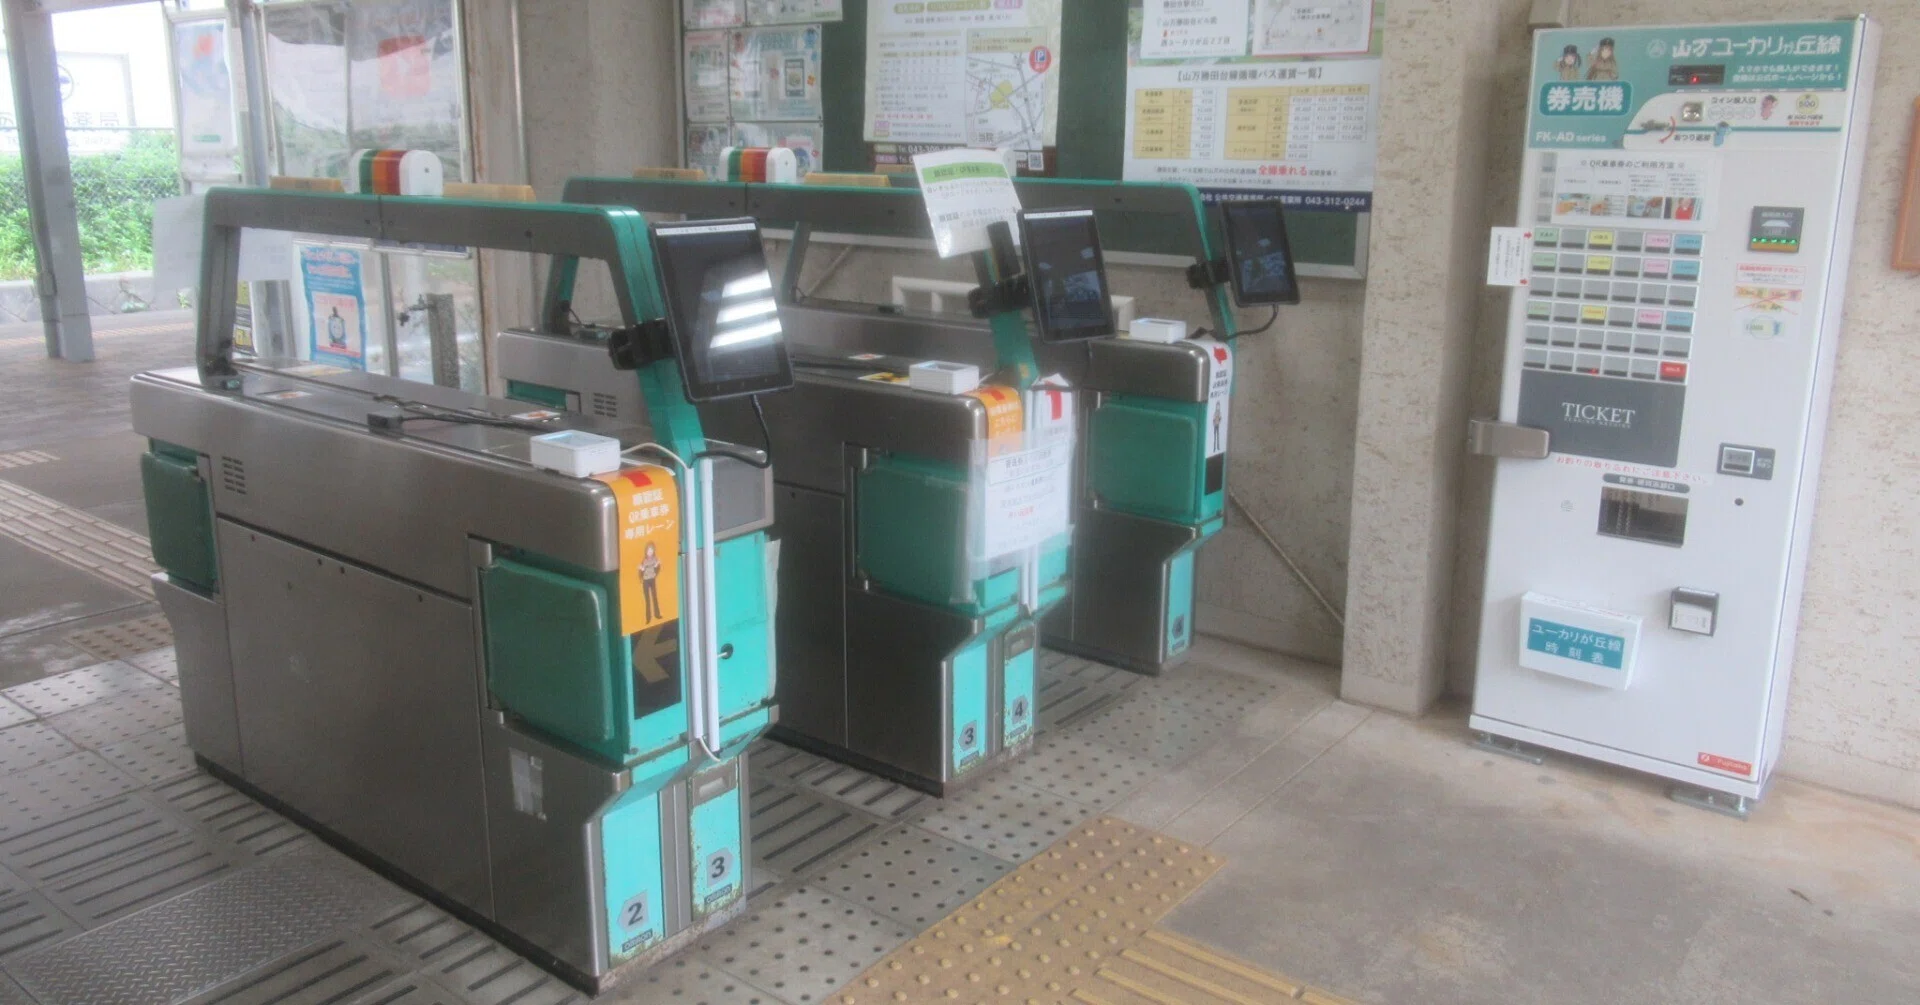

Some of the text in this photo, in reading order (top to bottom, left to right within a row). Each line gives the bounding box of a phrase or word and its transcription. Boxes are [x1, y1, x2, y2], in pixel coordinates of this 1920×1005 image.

[1547, 86, 1624, 112] 券売機
[1535, 131, 1607, 143] FK-AD series
[1305, 196, 1366, 206] 043-312-0244
[1561, 402, 1636, 425] TICKET
[1531, 624, 1622, 653] ユーカリが丘線
[1014, 701, 1024, 717] 4
[964, 727, 974, 745] 3
[711, 855, 726, 879] 3
[627, 901, 643, 926] 2
